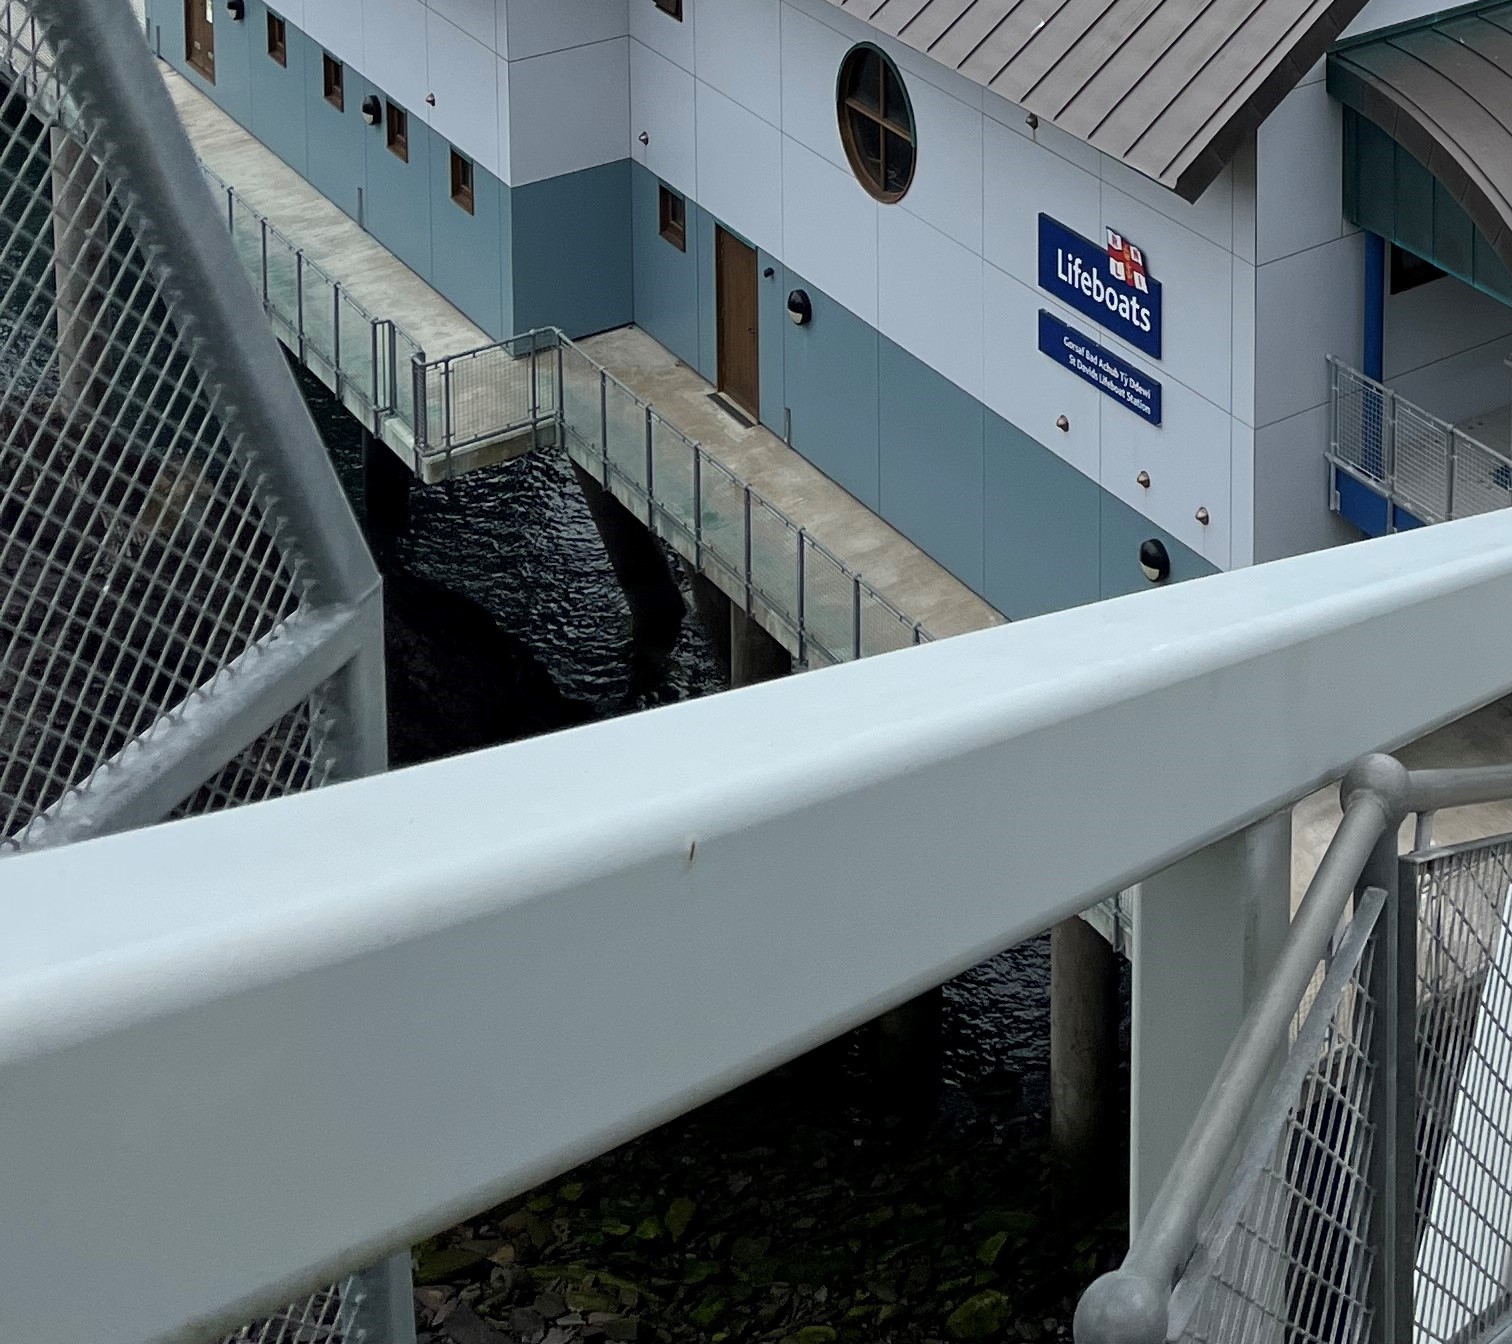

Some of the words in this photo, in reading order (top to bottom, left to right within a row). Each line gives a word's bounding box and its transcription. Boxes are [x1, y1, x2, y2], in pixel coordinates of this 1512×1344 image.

[1057, 248, 1151, 333] Lifeboats
[1063, 336, 1085, 357] Gorsaf
[1085, 349, 1098, 366] Bad
[1068, 353, 1077, 367] St
[1077, 358, 1099, 381] Davids
[1099, 373, 1126, 399] Lifeboat
[1126, 391, 1151, 415] Station
